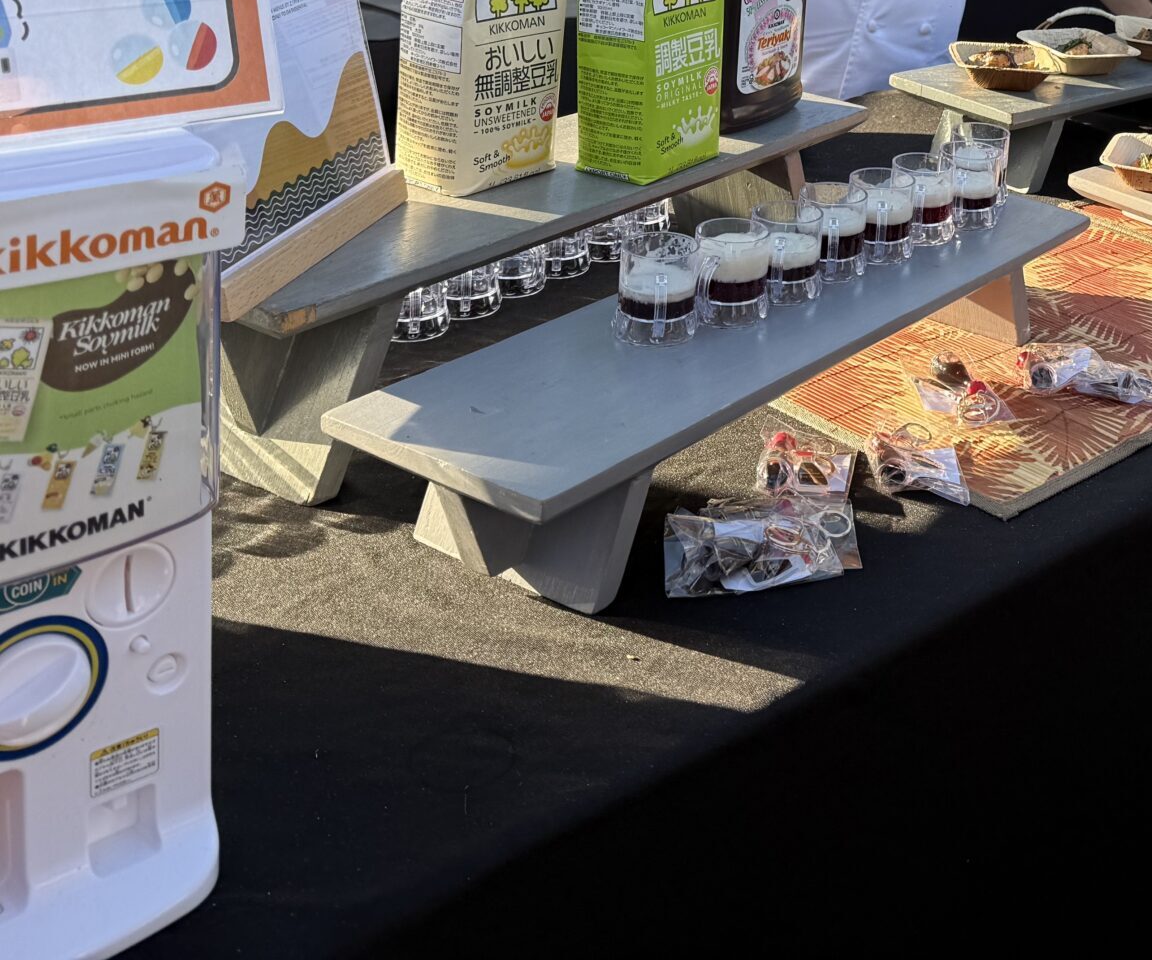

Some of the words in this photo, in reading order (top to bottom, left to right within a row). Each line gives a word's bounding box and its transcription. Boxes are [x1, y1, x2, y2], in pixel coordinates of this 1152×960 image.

[489, 16, 545, 35] KIKKOMAN
[663, 7, 707, 27] KIKKOMAN
[758, 27, 791, 50] Teriyaki
[485, 37, 554, 71] おいしい
[655, 28, 721, 77] 調製豆乳
[474, 58, 558, 101] 無調整豆乳
[656, 71, 702, 93] SOYMILK
[656, 82, 702, 102] ORIGINAL
[474, 97, 537, 118] SOYMILK
[474, 107, 537, 128] UNSWEETENED
[656, 136, 669, 149] Soft
[670, 132, 676, 141] &
[661, 136, 684, 155] Smooth
[473, 153, 491, 165] Soft
[493, 150, 500, 158] &
[479, 154, 511, 173] Smooth
[58, 297, 171, 342] Kikkoman
[73, 315, 160, 357] Soymilk
[75, 360, 98, 373] NOW
[100, 356, 110, 367] IN
[110, 351, 130, 365] MINI
[130, 343, 155, 358] FORM!
[0, 499, 145, 561] KIKKOMAN
[11, 579, 43, 600] COIN
[53, 571, 68, 586] IN
